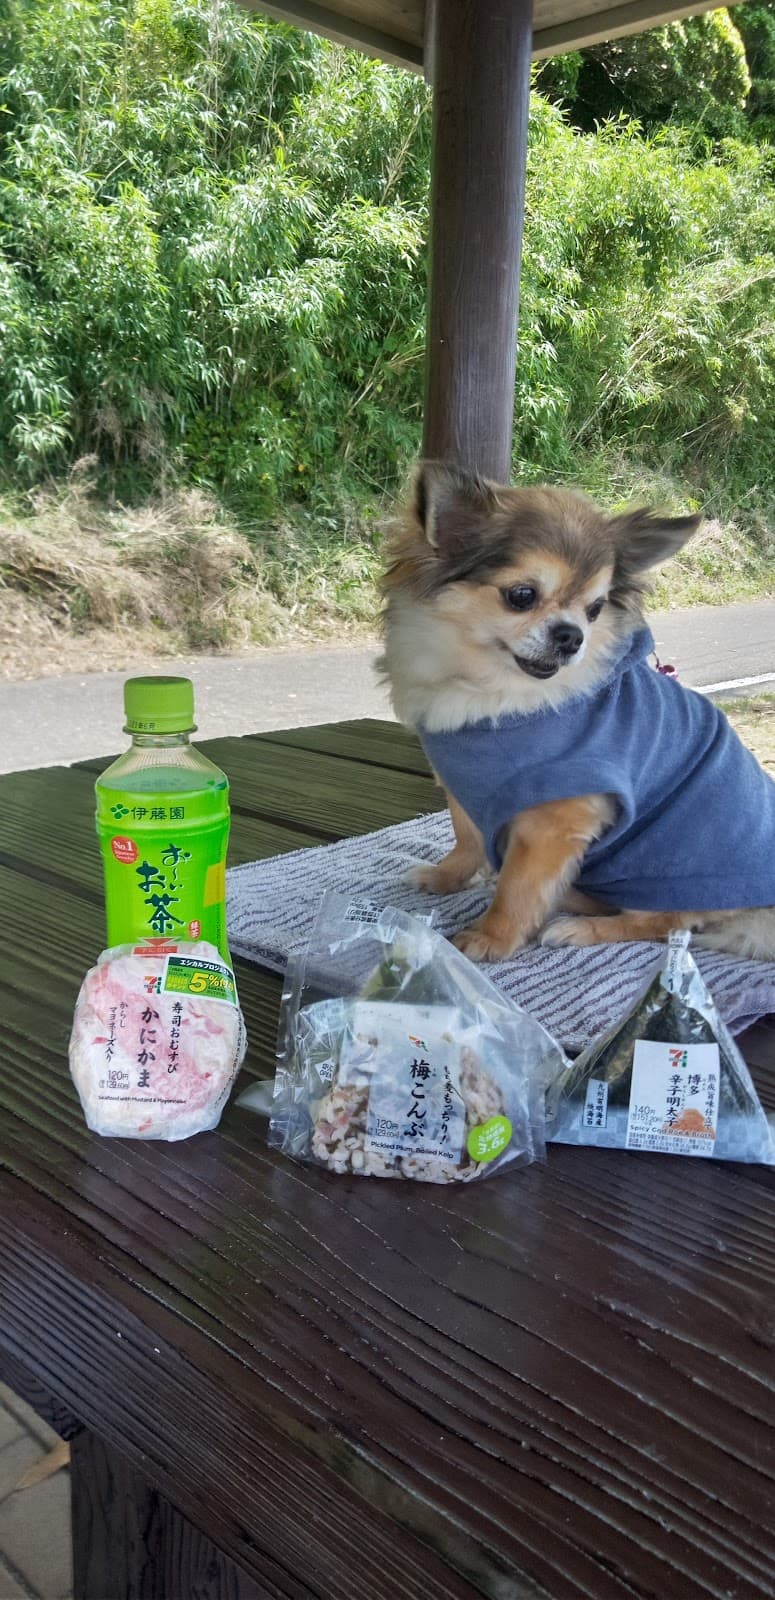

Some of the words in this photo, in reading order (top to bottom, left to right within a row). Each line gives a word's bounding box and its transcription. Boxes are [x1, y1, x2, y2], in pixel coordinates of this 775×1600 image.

[130, 806, 185, 820] 伊藤園
[119, 1001, 129, 1028] からし
[137, 1006, 159, 1089] かにかま
[167, 1002, 184, 1073] 寿司おむすび
[404, 1058, 431, 1137] 梅こんぶ
[664, 1074, 683, 1127] 辛子明太子
[687, 1074, 701, 1096] 博多
[371, 1141, 394, 1149] Pickled
[439, 1151, 454, 1159] Kelp
